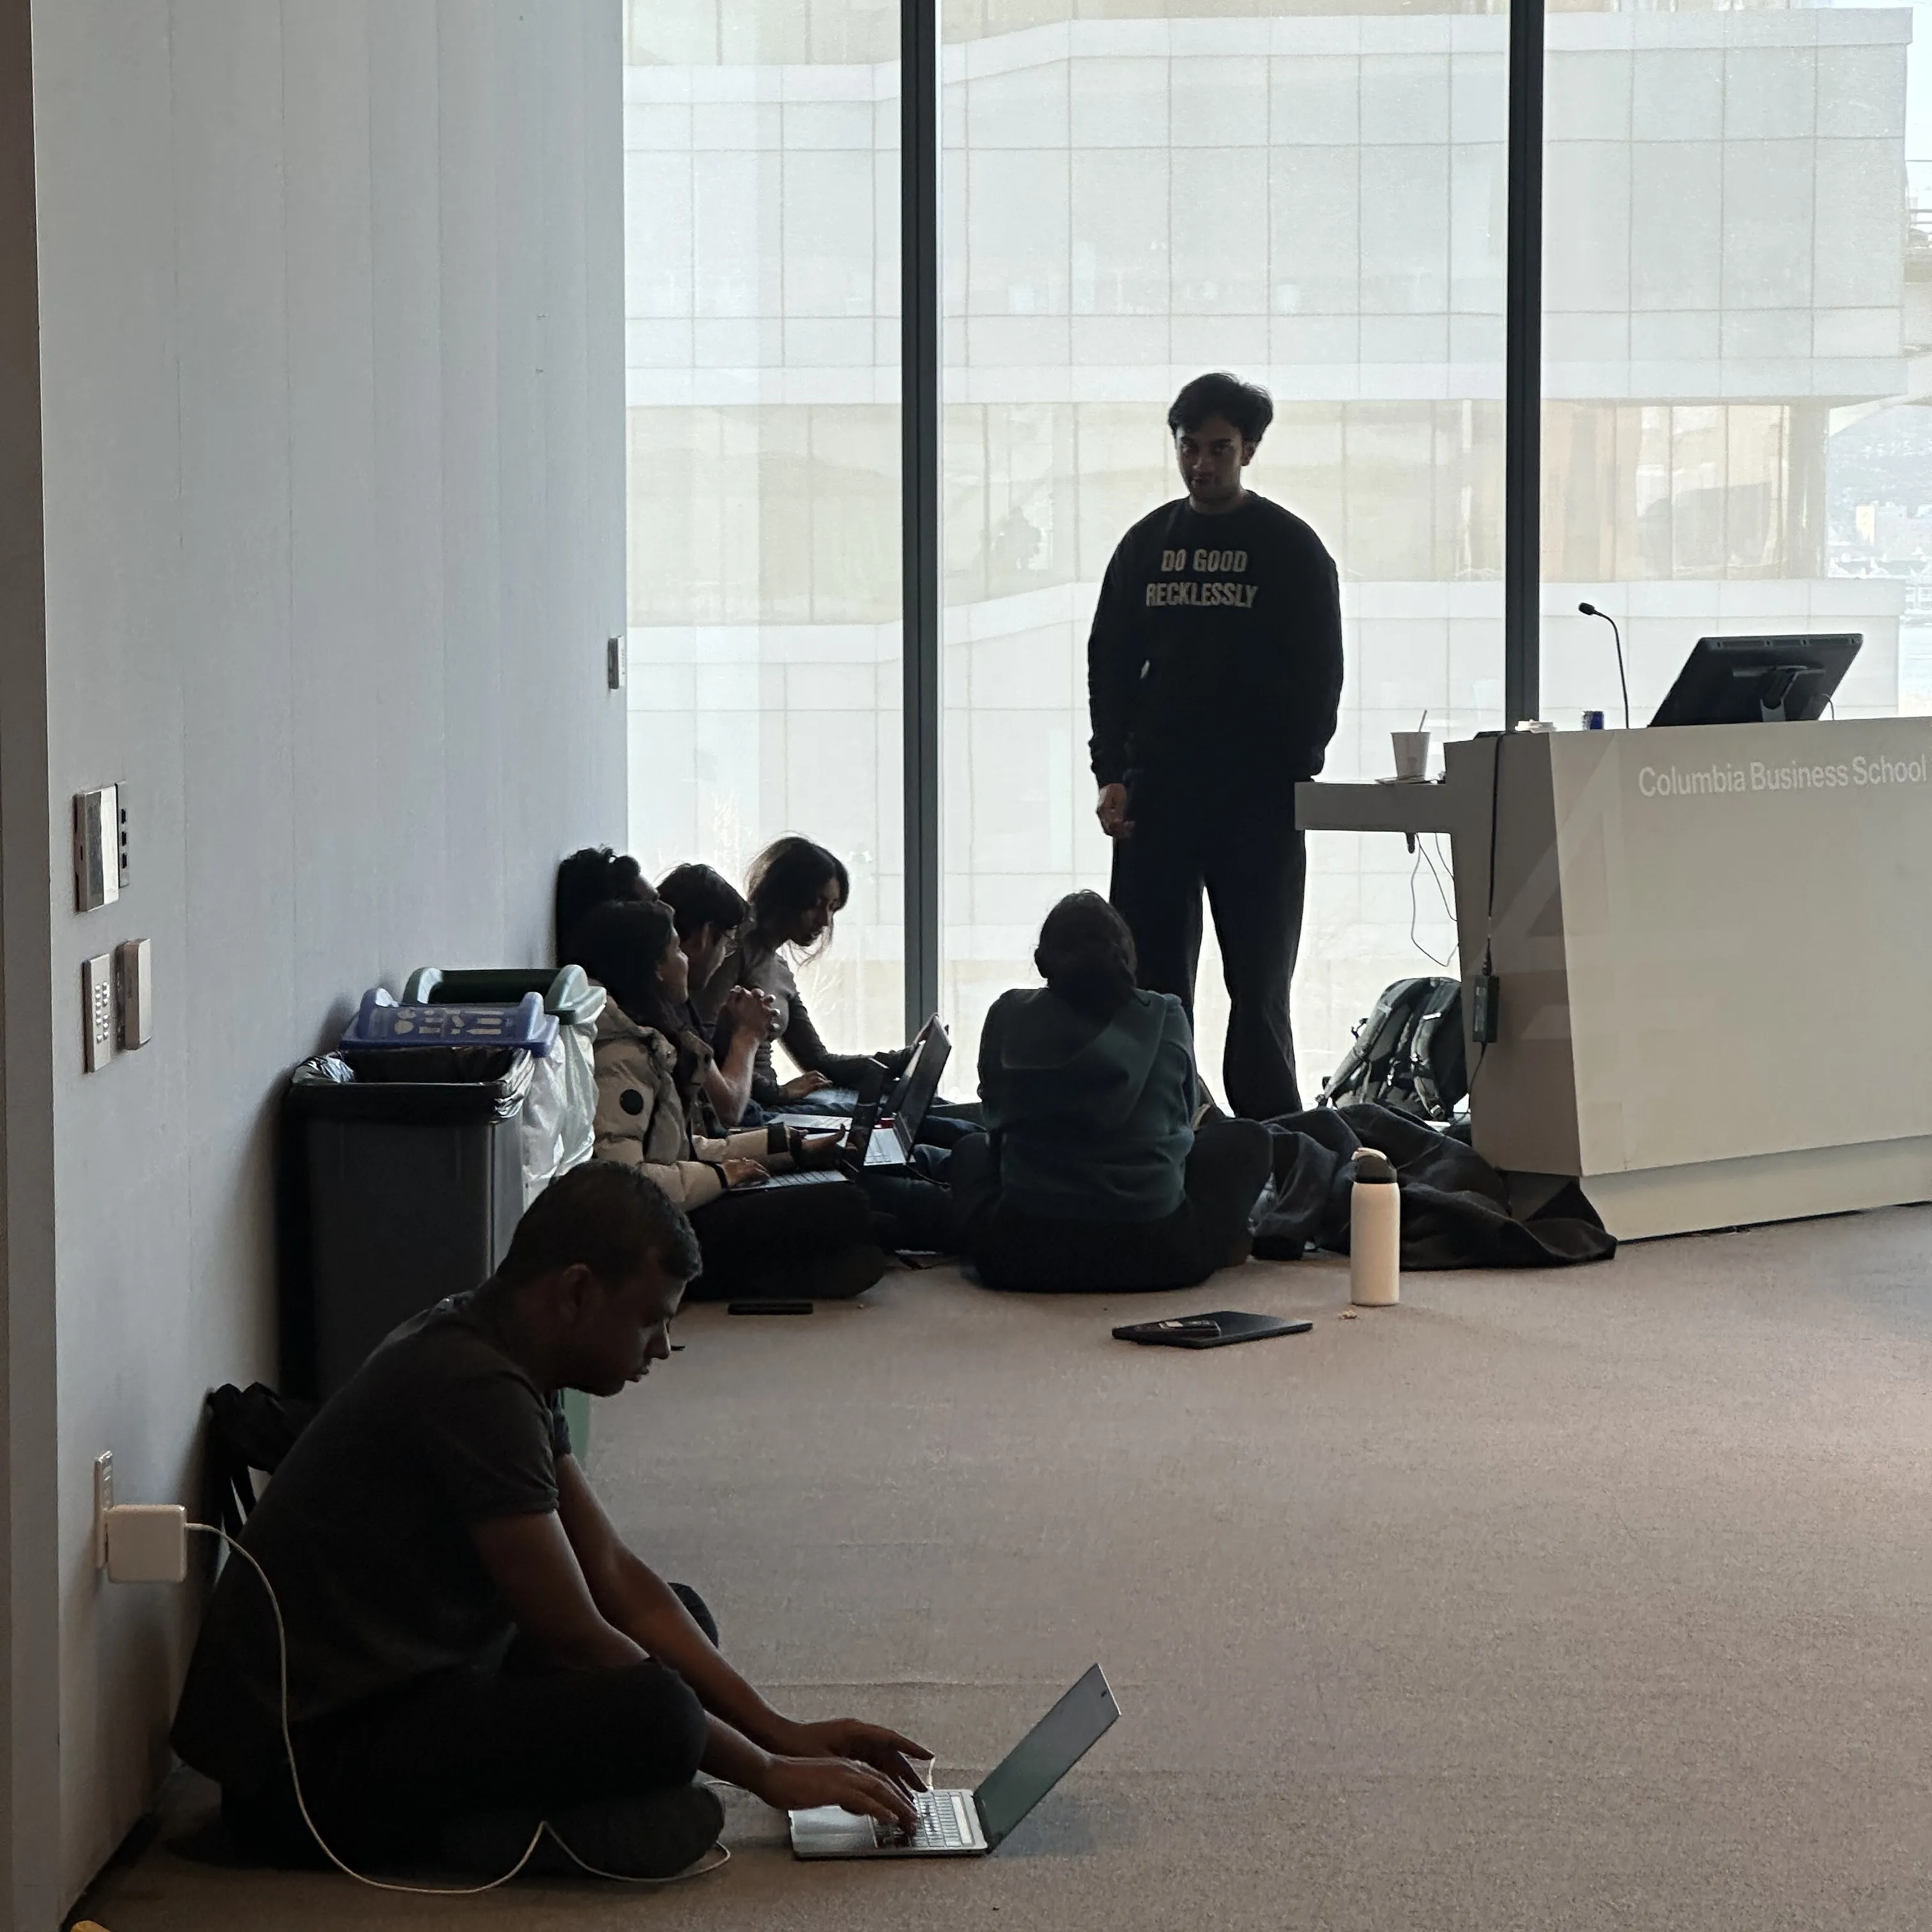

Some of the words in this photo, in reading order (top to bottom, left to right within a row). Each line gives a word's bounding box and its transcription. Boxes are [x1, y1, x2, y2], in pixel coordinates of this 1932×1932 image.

[1161, 549, 1186, 572] DO
[1193, 548, 1248, 572] GOOD
[1146, 582, 1259, 608] RECKLESSLY
[1639, 763, 1746, 797] Columbia
[1750, 761, 1848, 792] Business
[1852, 755, 1926, 785] School
